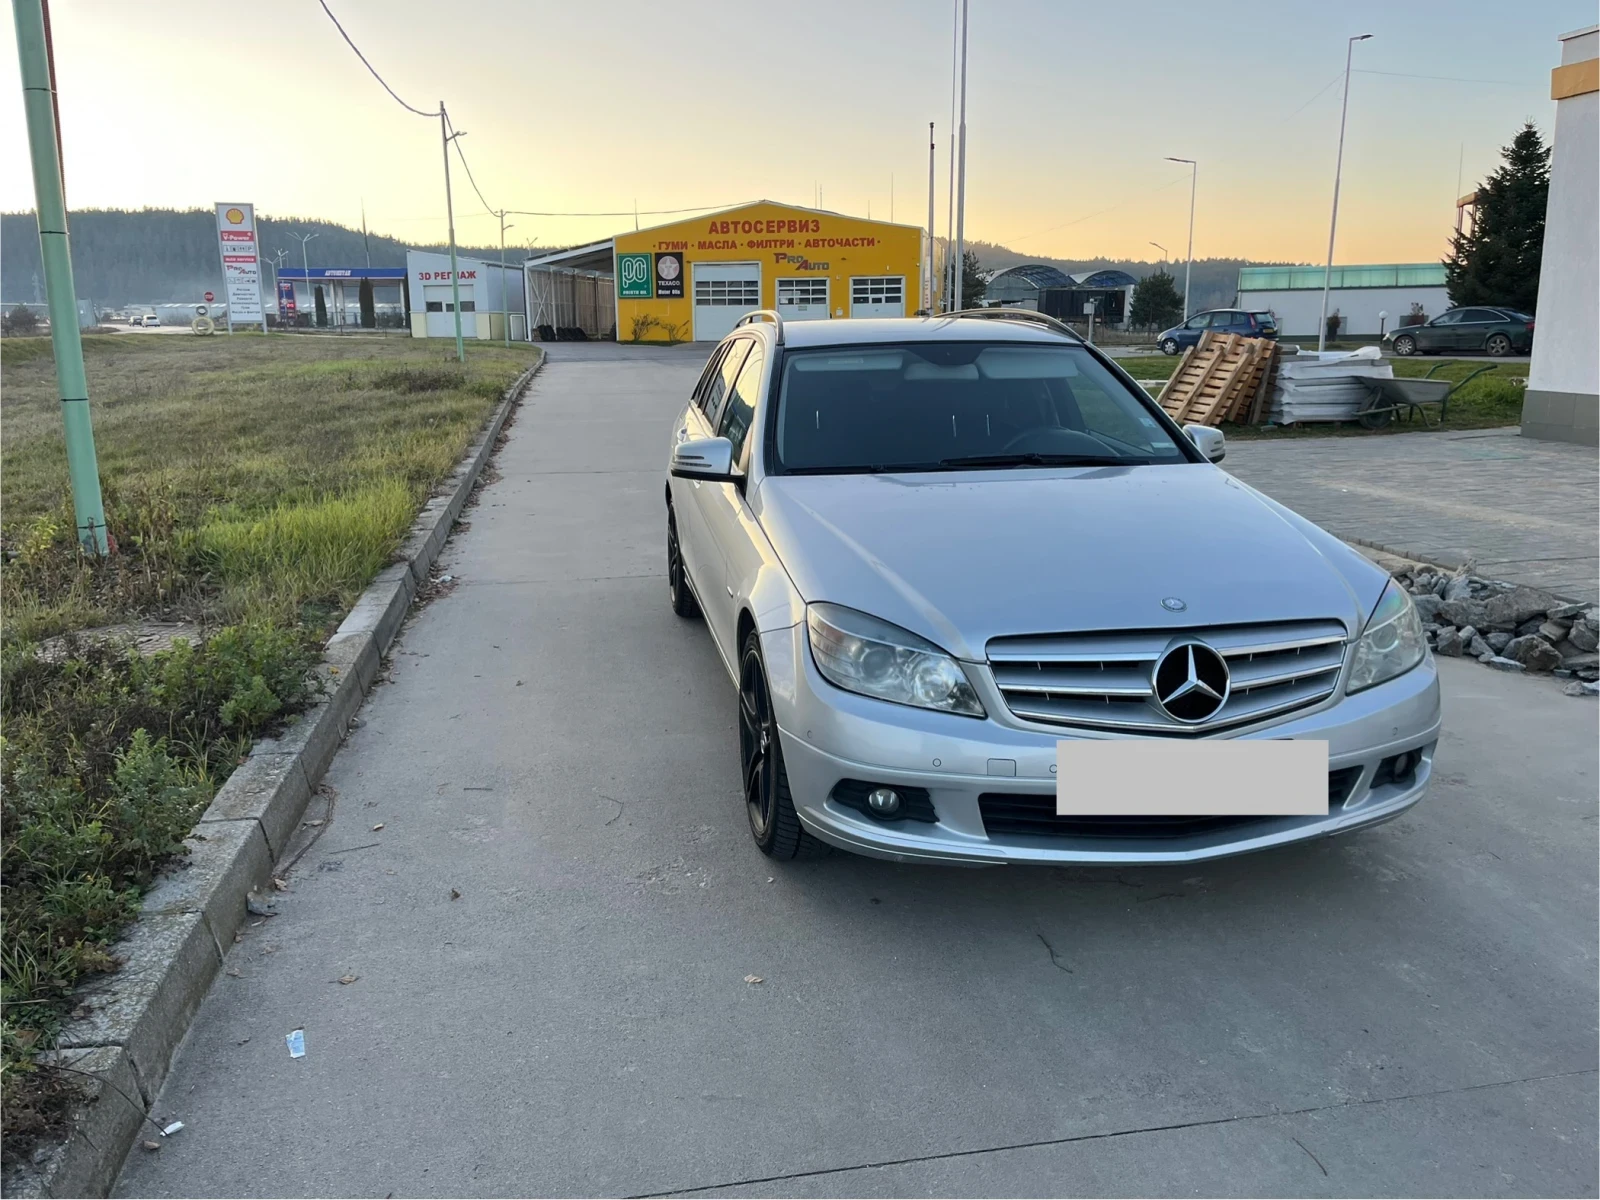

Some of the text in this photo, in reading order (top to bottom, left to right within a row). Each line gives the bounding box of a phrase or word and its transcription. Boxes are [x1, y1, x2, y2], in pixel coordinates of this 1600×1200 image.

[708, 219, 820, 235] АВТОСЕРВИЗ
[658, 237, 875, 251] ГУМИ МАСЛА ФИЛТРИ АВТОЧАСТИ
[418, 272, 431, 281] 3D
